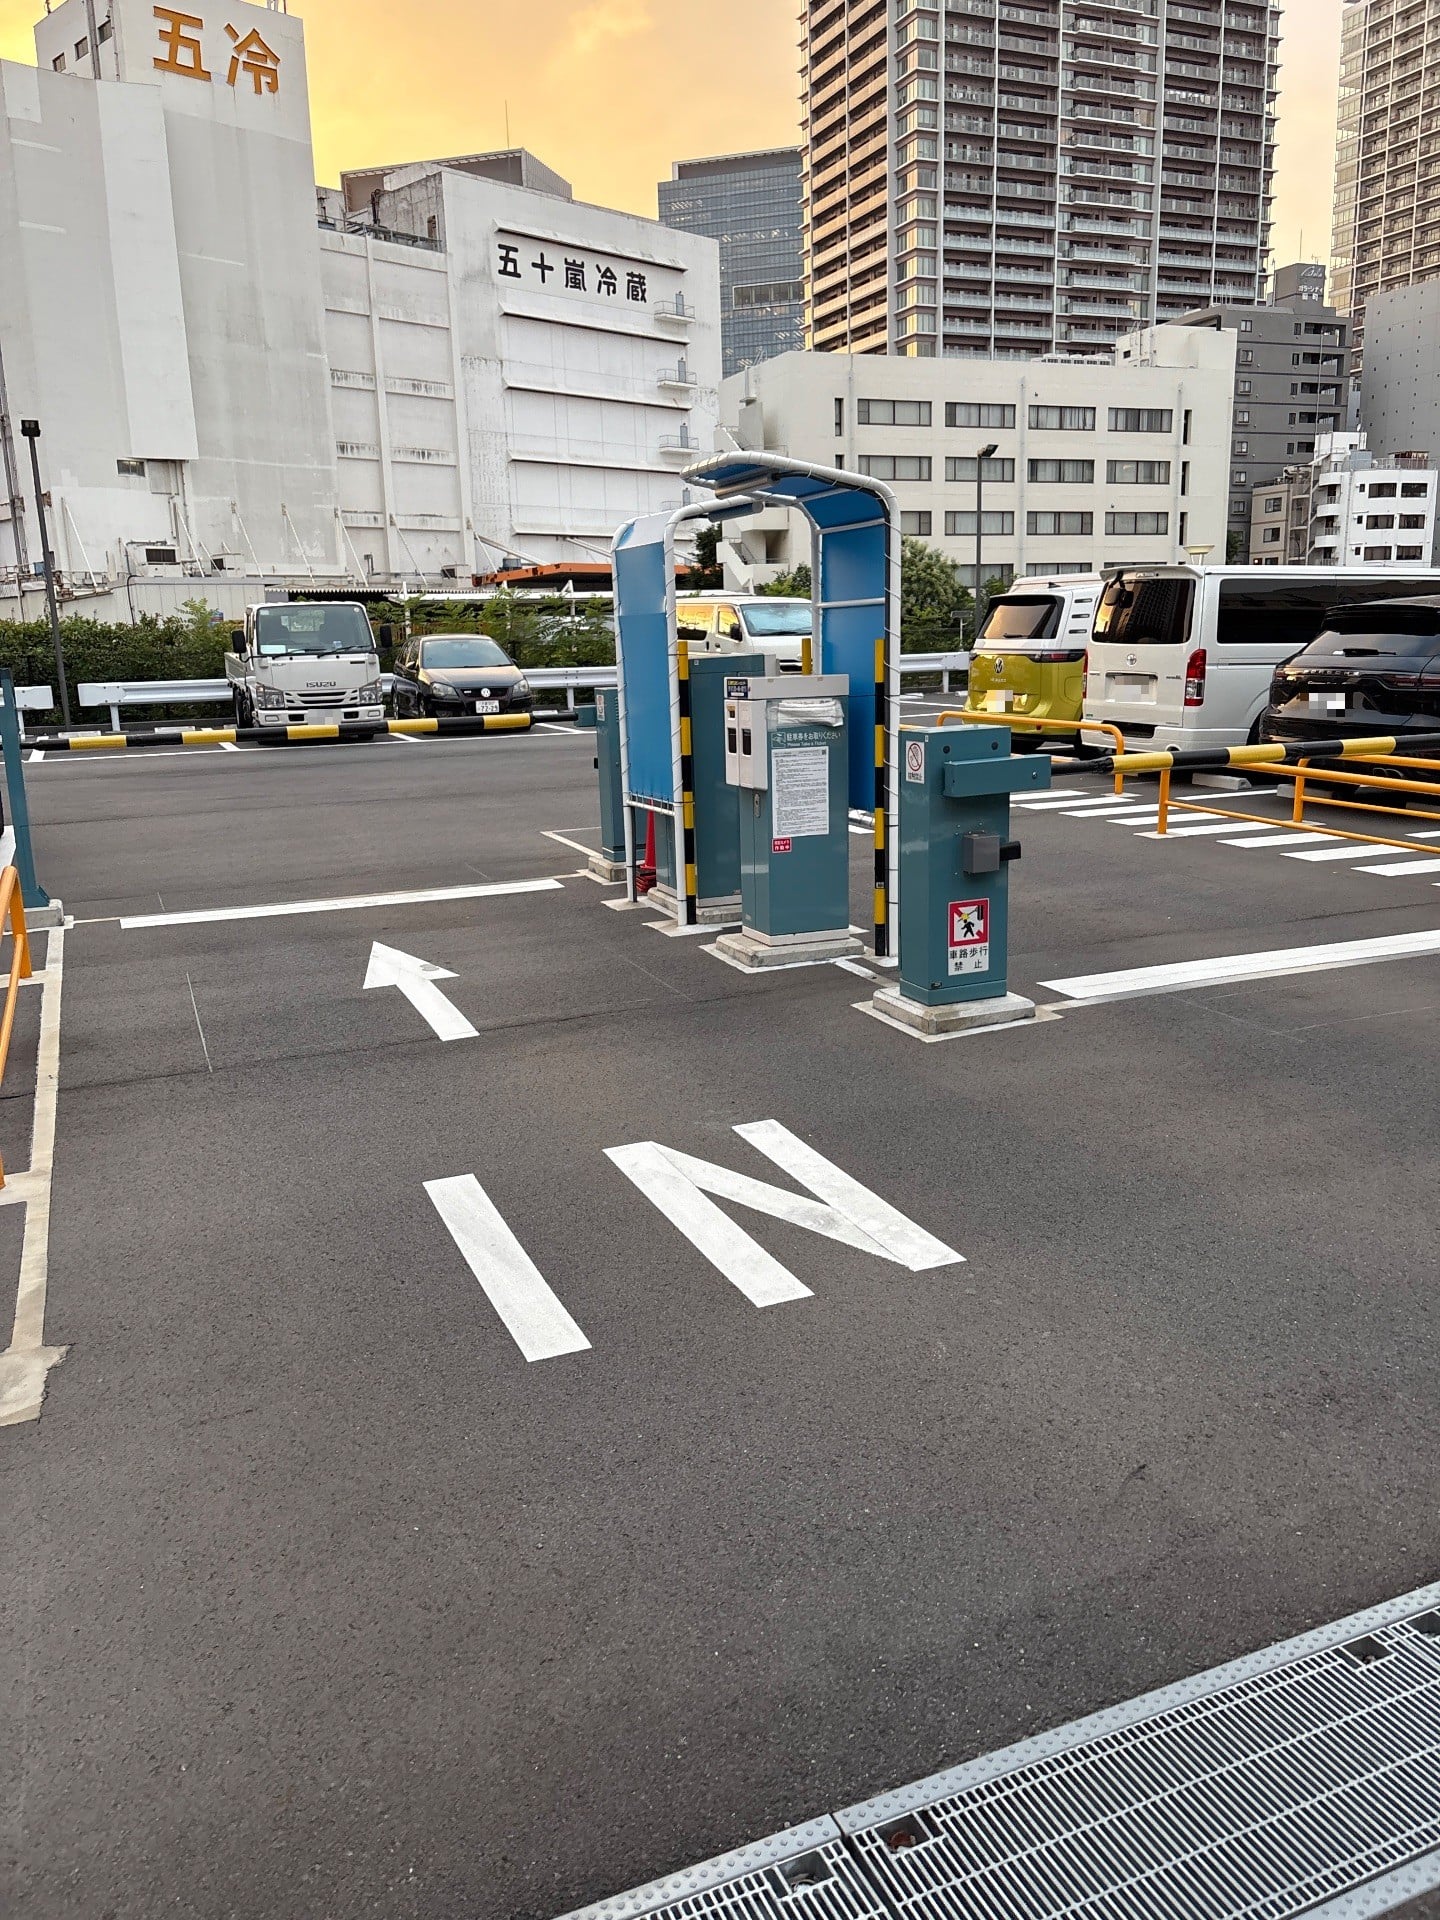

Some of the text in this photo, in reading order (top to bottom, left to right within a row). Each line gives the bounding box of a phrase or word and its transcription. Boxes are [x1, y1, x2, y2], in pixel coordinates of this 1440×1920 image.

[153, 5, 280, 95] 五冷
[498, 244, 647, 303] 五十嵐冷蔵
[950, 945, 988, 960] 車路歩行
[954, 959, 983, 972] 禁止
[422, 1118, 967, 1363] IN
